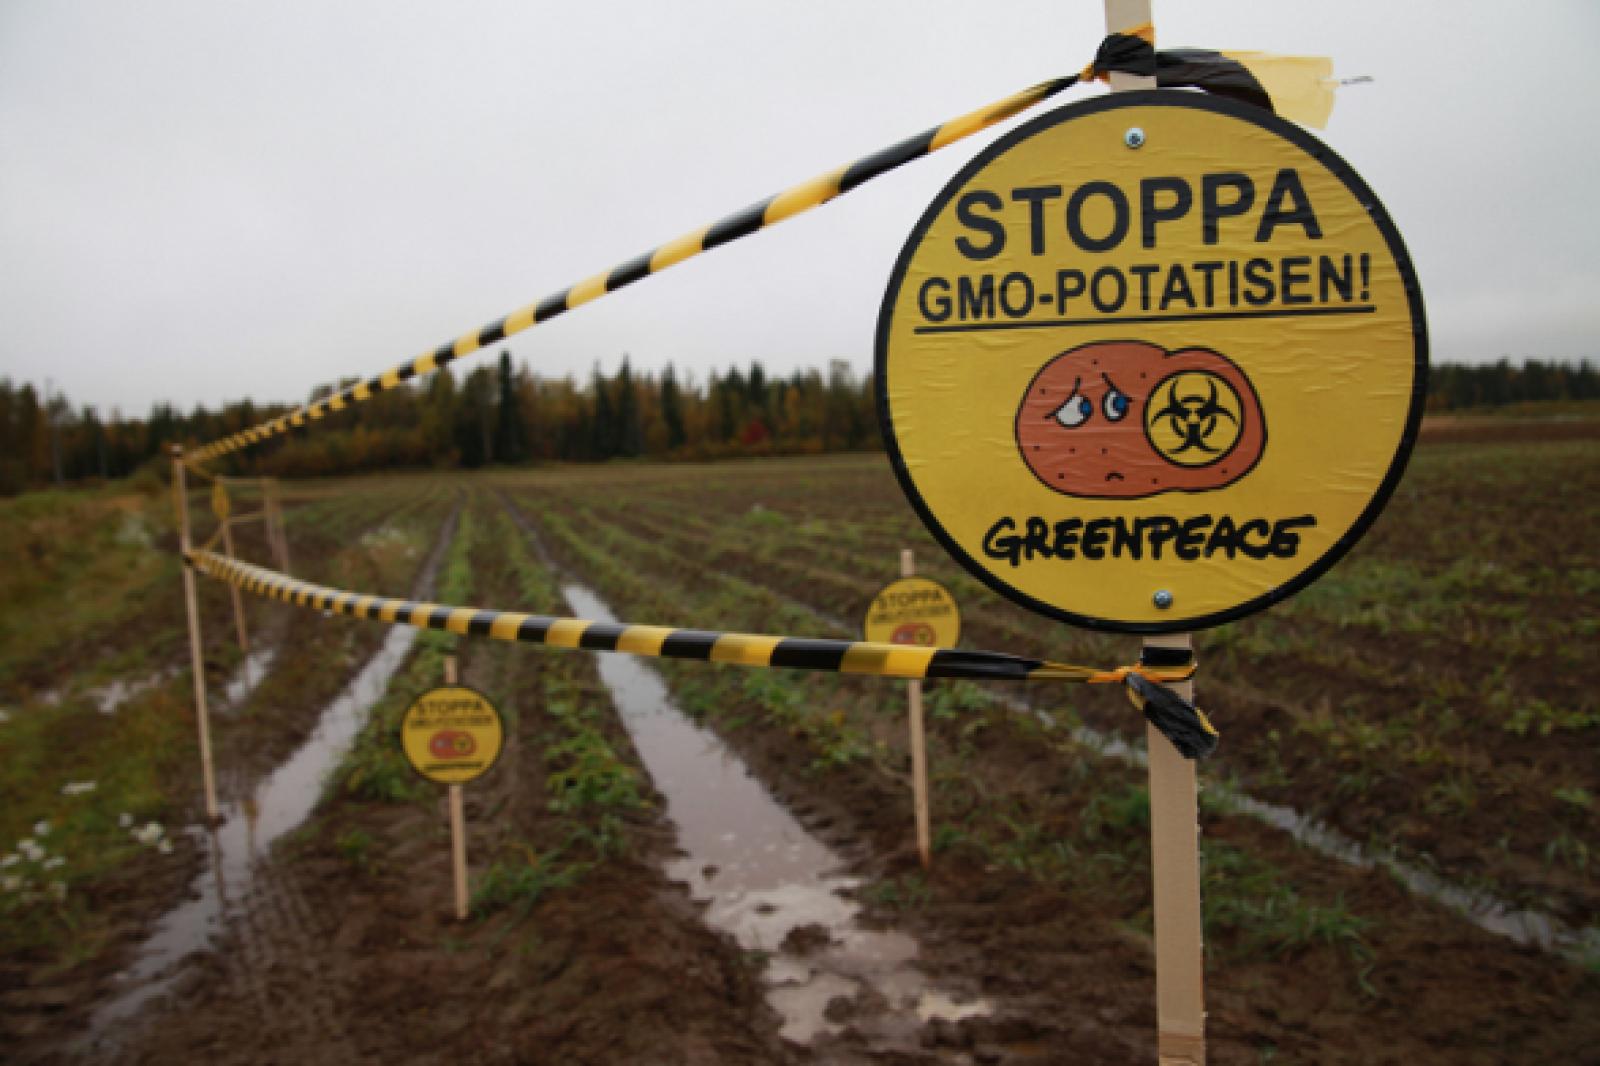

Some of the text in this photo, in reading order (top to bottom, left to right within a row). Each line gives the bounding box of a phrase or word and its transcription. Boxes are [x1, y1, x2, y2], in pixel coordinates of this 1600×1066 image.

[955, 168, 1323, 261] STOPPA
[918, 253, 1372, 323] GMO-POTATISEN!
[982, 514, 1317, 568] GREENPEACE
